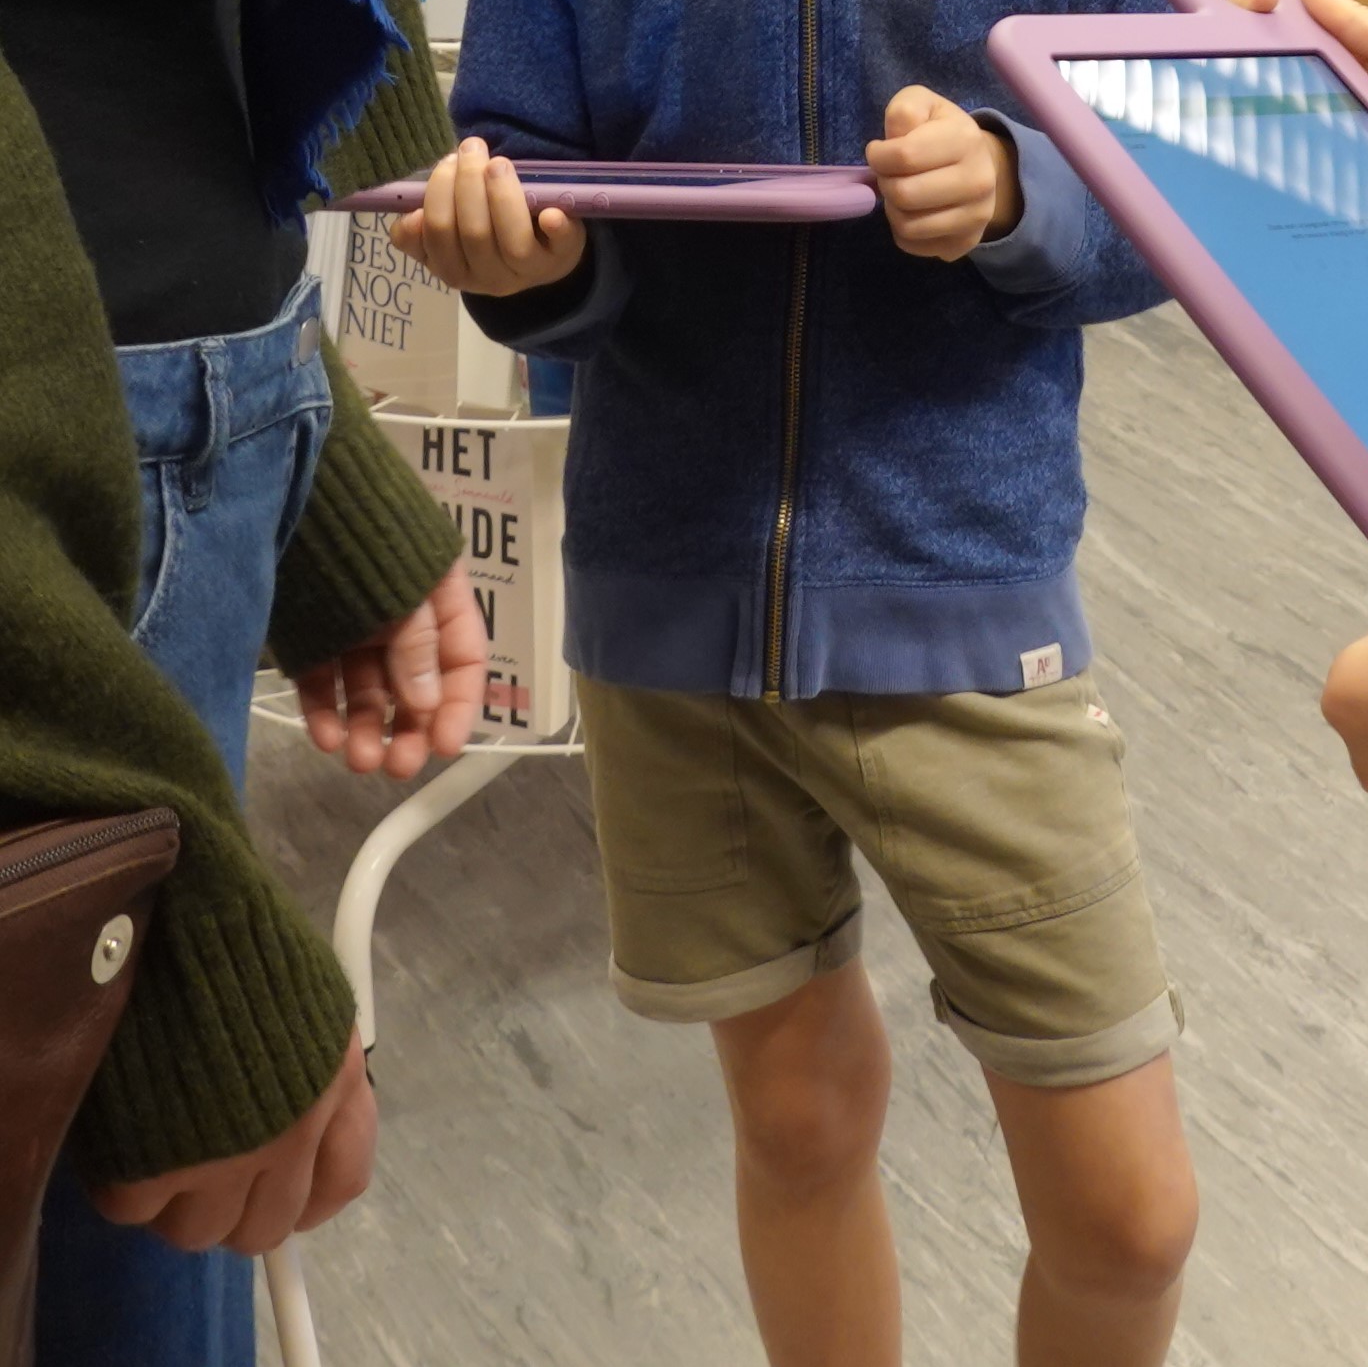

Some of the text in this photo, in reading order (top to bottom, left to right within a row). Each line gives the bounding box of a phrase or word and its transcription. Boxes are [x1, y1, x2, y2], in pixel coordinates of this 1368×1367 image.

[348, 266, 413, 316] NOG
[344, 301, 413, 350] NIET
[423, 427, 496, 481] HET
